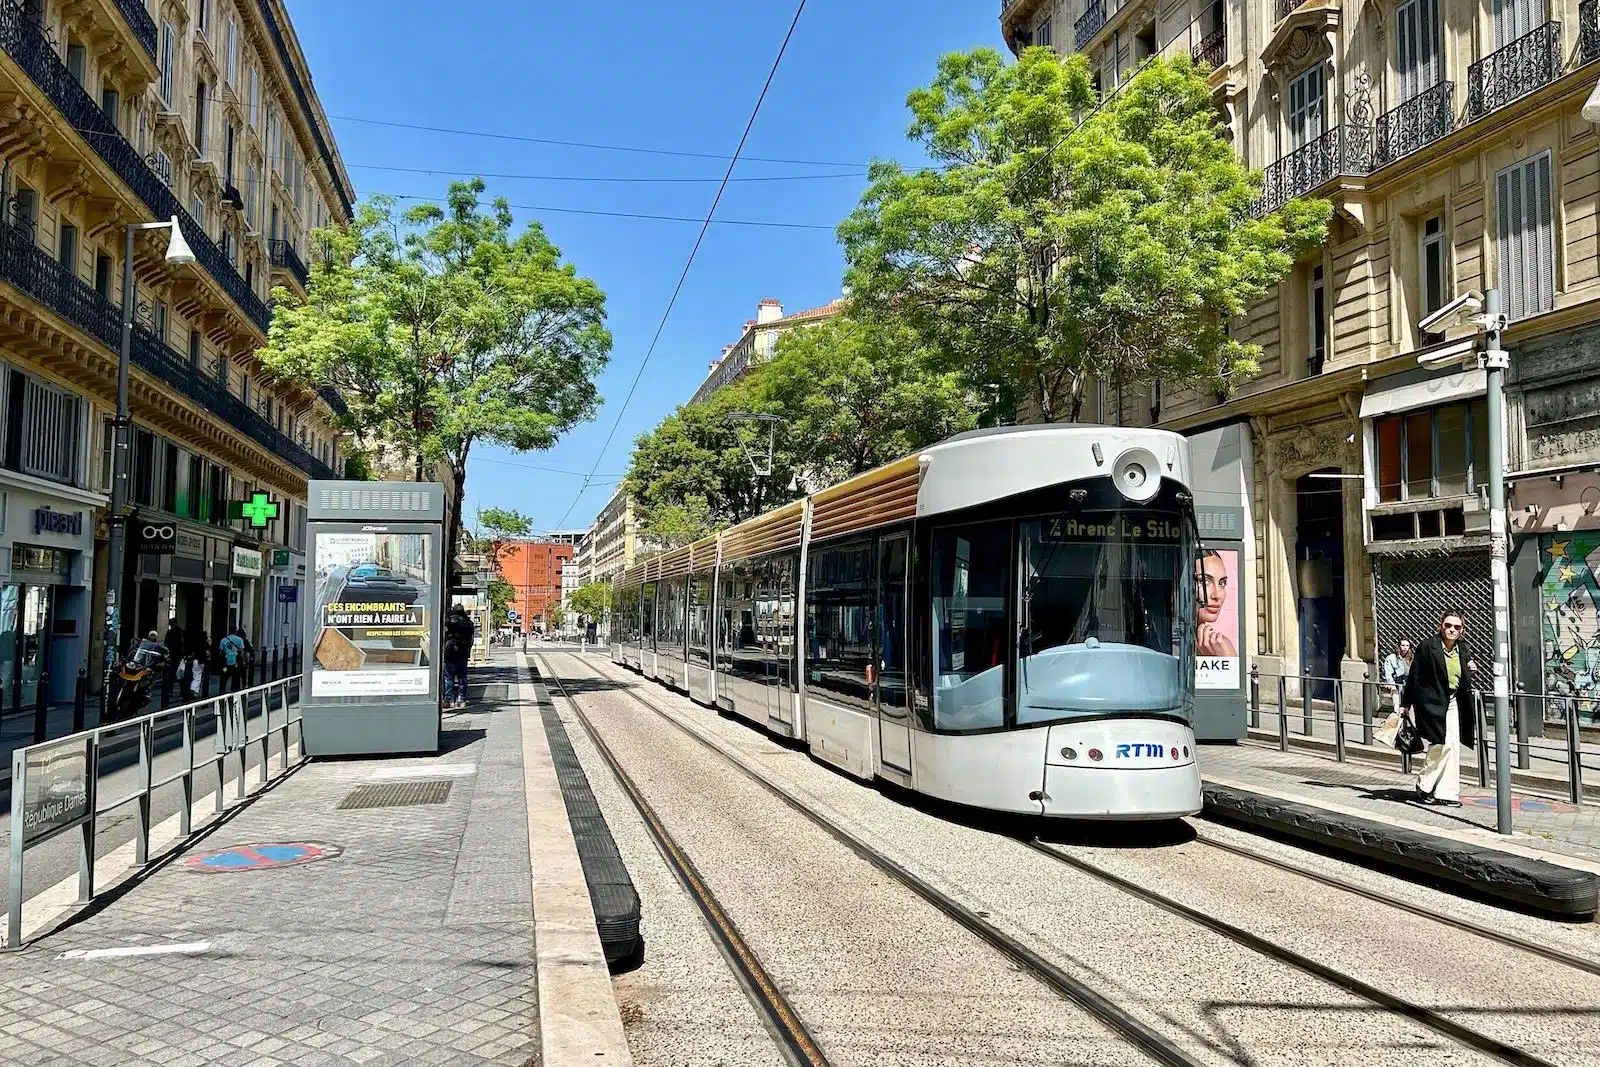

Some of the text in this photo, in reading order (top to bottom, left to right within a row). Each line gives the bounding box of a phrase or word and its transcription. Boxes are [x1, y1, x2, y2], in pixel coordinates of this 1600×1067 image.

[1067, 519, 1116, 537] Arenc
[1121, 519, 1141, 538] Le
[1147, 519, 1181, 538] Silo
[327, 602, 406, 612] CES ENCOMBRANTS
[353, 613, 373, 624] RIEN
[374, 612, 381, 623] À
[382, 613, 405, 623] FAIRE
[406, 612, 417, 623] LÀ
[1195, 660, 1230, 671] AKE
[1115, 743, 1164, 759] RTM
[24, 792, 87, 829] République Dames
